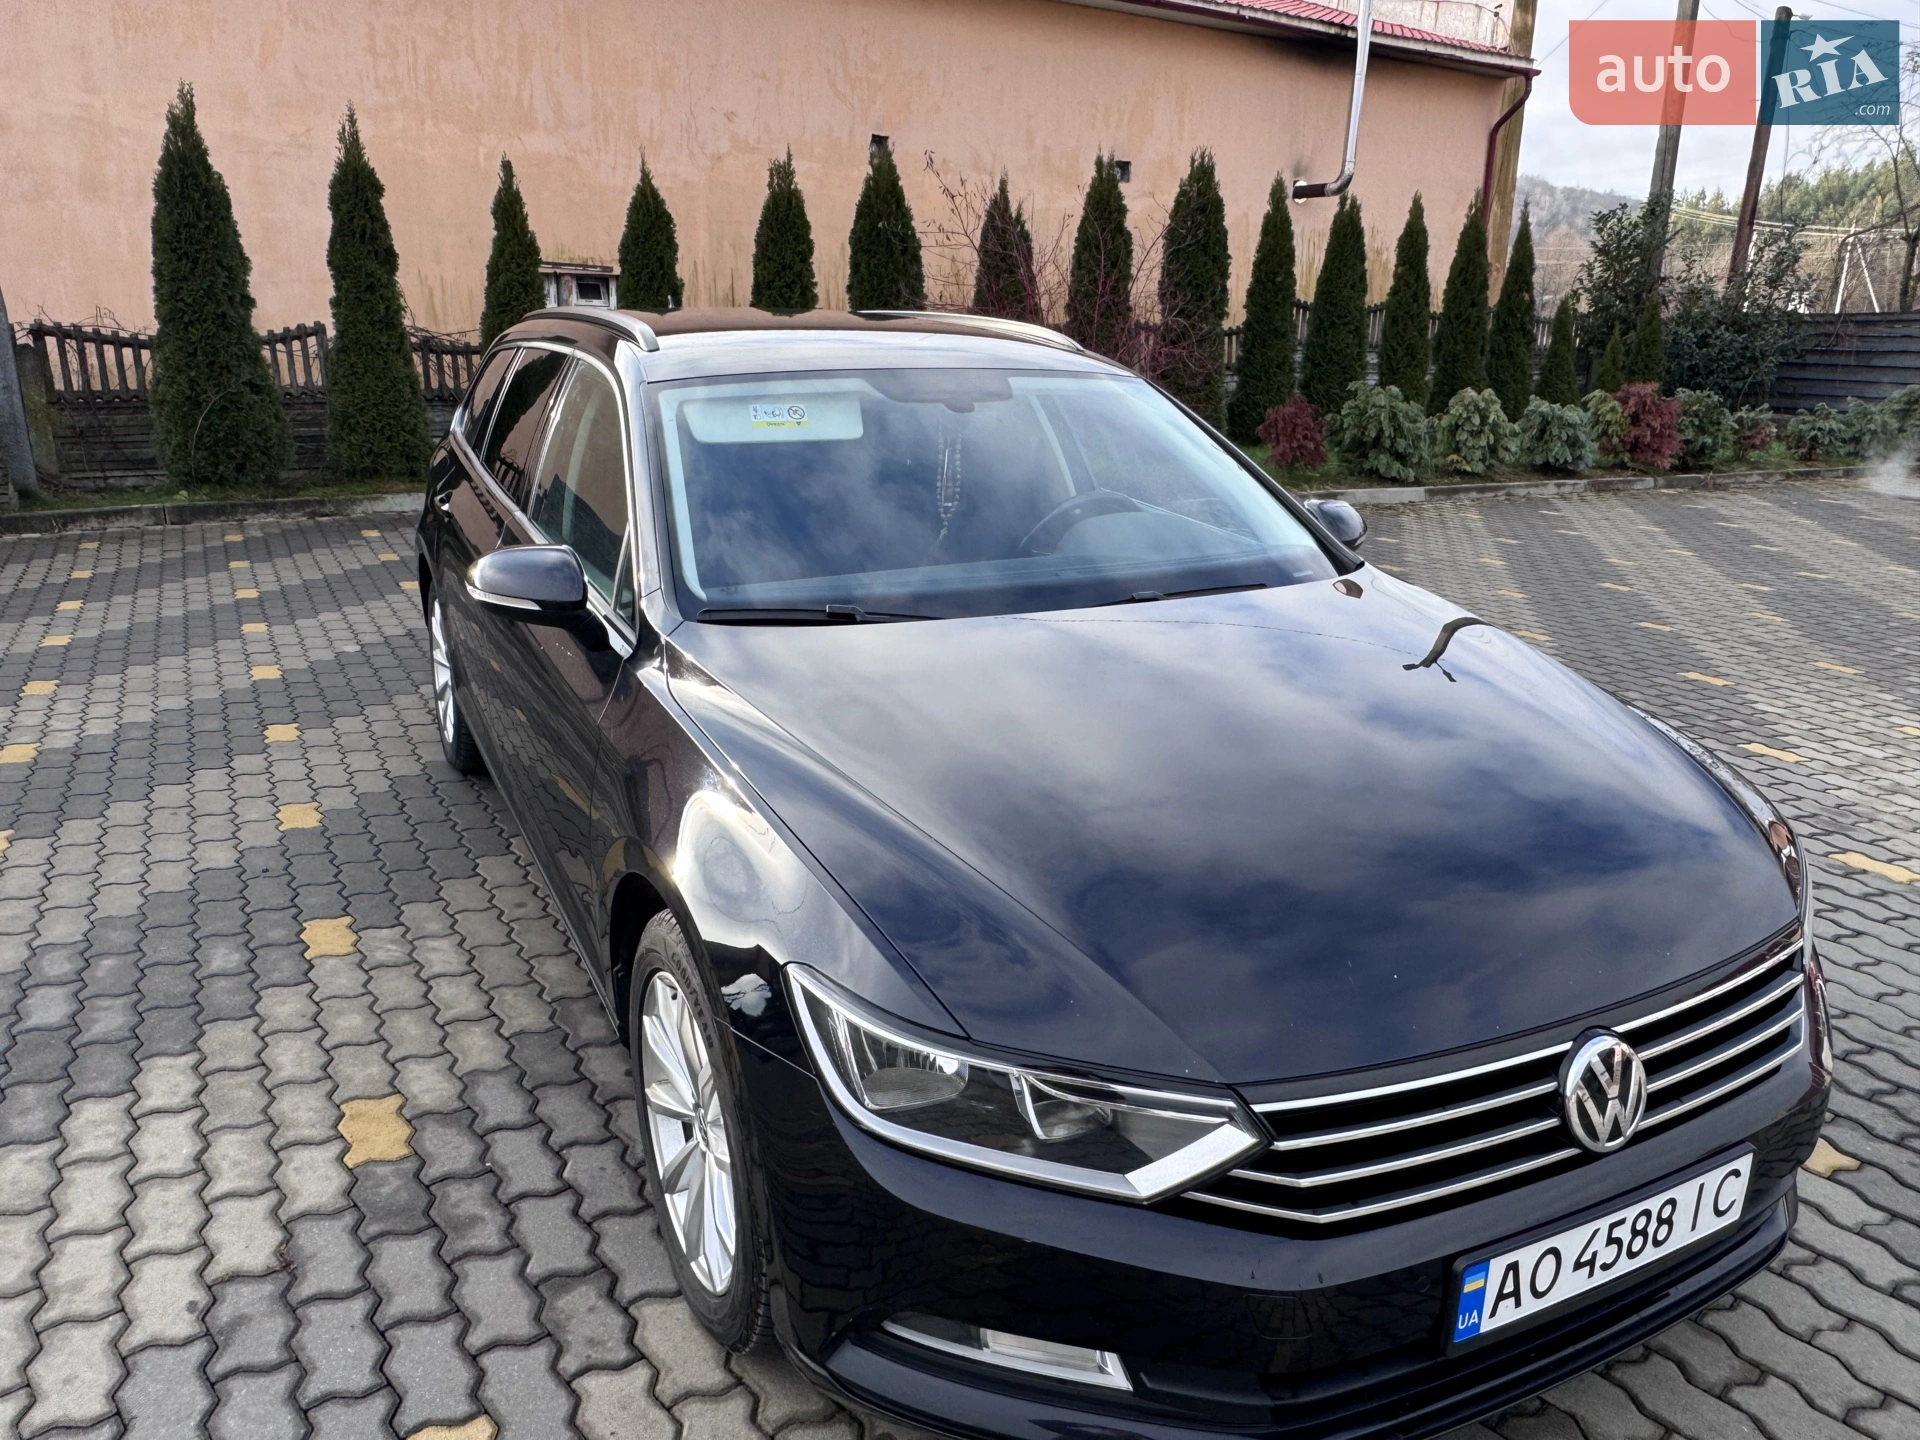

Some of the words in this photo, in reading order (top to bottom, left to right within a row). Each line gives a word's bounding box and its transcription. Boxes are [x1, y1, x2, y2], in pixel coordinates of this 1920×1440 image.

[1573, 1042, 1643, 1148] VW
[1488, 1246, 1562, 1320] AO
[1572, 1196, 1678, 1279] 4588
[1690, 1168, 1742, 1232] IC
[1458, 1310, 1479, 1330] UA
